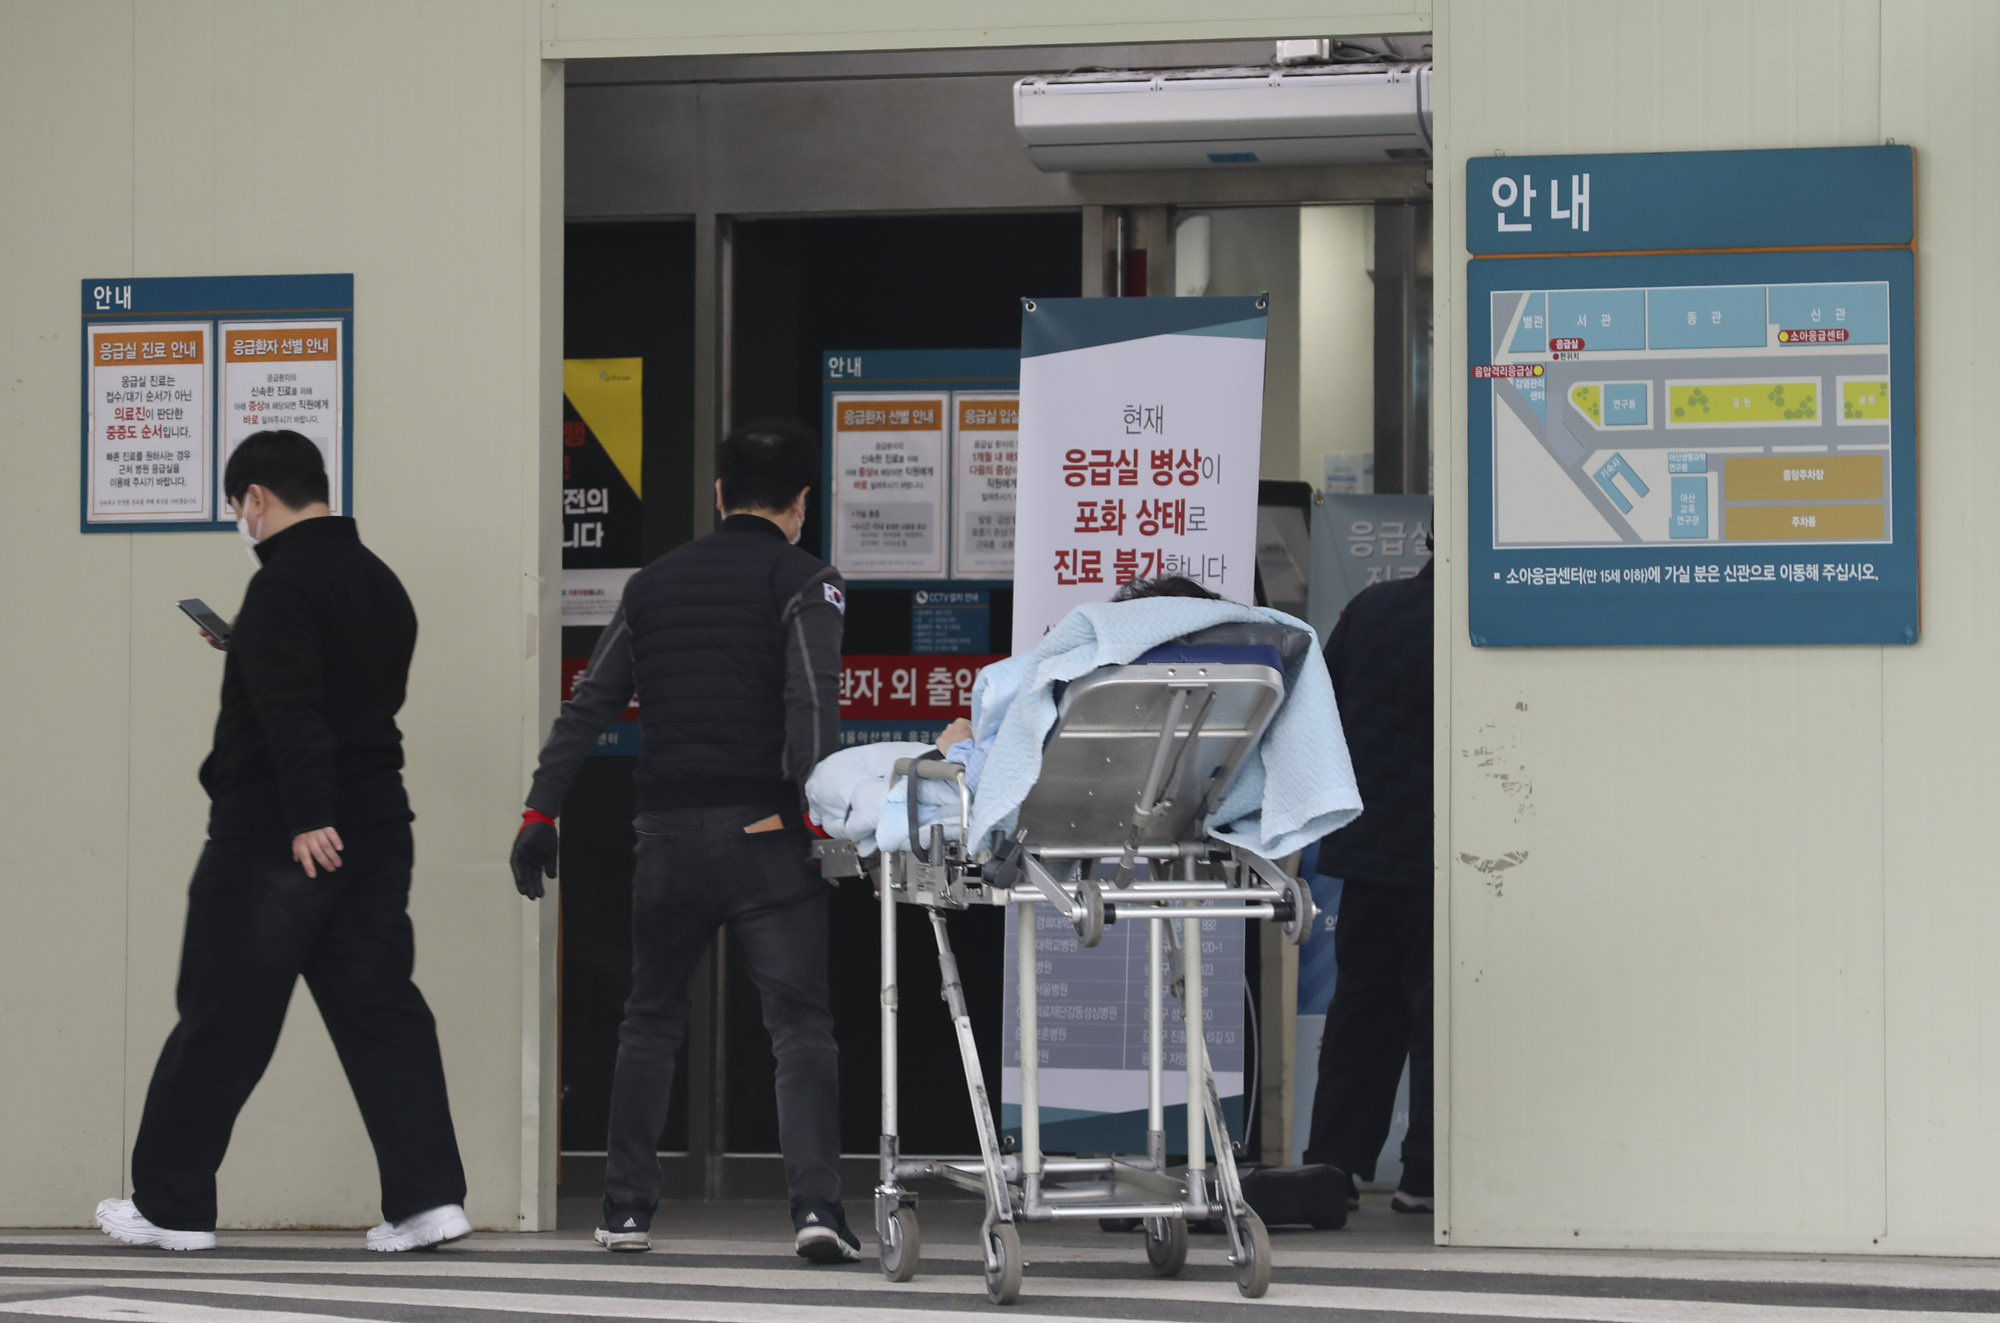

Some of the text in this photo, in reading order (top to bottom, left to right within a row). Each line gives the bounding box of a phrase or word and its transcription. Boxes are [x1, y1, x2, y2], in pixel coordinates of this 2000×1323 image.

[1491, 172, 1590, 232] 안내
[93, 285, 132, 310] 안내
[1522, 315, 1544, 329] 별관
[1789, 330, 1845, 342] 소아응급센터
[99, 340, 196, 361] 응급실 진료 안내
[233, 337, 329, 356] 응급환자 선별 안내
[1555, 339, 1579, 350] 응급실
[1559, 351, 1580, 361] 현위치
[828, 356, 862, 378] 안내
[1474, 365, 1533, 378] 음압격리응급실
[121, 375, 176, 388] 응급실 진료는
[105, 389, 192, 404] 접수/대기 순서가 아닌
[251, 386, 274, 397] 신속한
[1530, 390, 1545, 401] 센터
[298, 398, 329, 410] 직원에게
[114, 406, 184, 422] 의료진이 판단한
[243, 414, 259, 425] 바로
[844, 408, 934, 425] 응급환자 선별 안내
[965, 409, 997, 425] 응급실
[1122, 404, 1163, 435] 현재
[106, 423, 192, 441] 중증도 순서입니다.
[122, 451, 143, 462] 진료를
[176, 450, 191, 461] 경우
[118, 462, 180, 475] 근처 병원 응급실을
[1062, 448, 1221, 487] 응급실 병상이
[1600, 457, 1622, 479] 기숙사
[1783, 469, 1824, 481] 중앙주차장
[109, 477, 131, 488] 이용해
[132, 476, 154, 488] 주시기
[1680, 493, 1696, 503] 아산
[1074, 498, 1208, 537] 포화 상태로
[1053, 548, 1104, 585] 진료
[1600, 569, 1620, 584] 15세
[1623, 566, 1661, 584] 이하)에
[1665, 565, 1690, 583] 가실
[1694, 565, 1721, 583] 분은
[1724, 564, 1777, 582] 신관으로
[1780, 563, 1819, 582] 이동해
[1822, 563, 1879, 582] 주십시오.
[890, 667, 917, 706] 외
